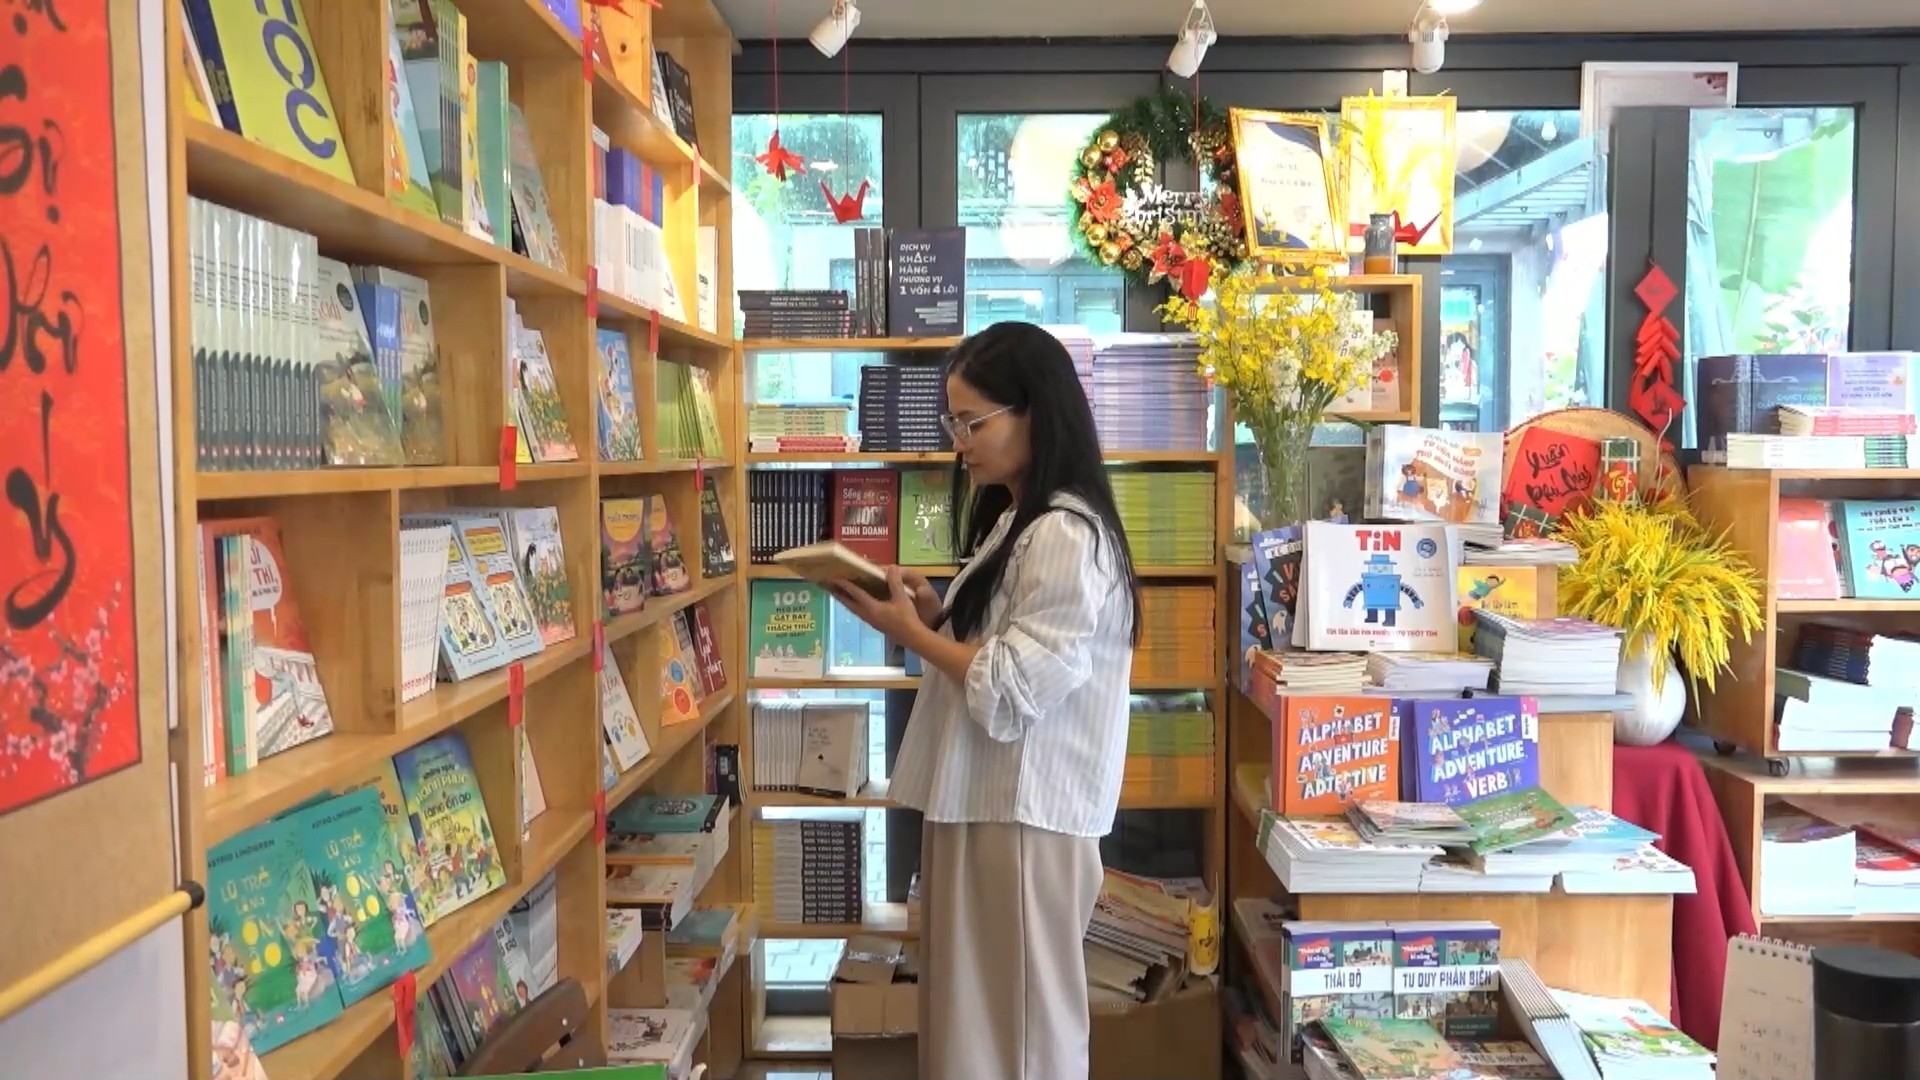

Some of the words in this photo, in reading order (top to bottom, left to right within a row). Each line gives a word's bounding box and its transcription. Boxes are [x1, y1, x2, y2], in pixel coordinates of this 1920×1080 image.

[1140, 182, 1206, 210] Merry
[900, 286, 907, 295] 1
[932, 285, 941, 295] 4
[841, 526, 860, 536] KINH
[862, 526, 889, 536] DOANH
[773, 590, 811, 607] 100
[1300, 712, 1384, 746] ALPHABET
[1430, 714, 1517, 756] ALPHABET
[1300, 737, 1389, 774] ADVENTURE
[1432, 740, 1525, 784] ADVENTURE
[1303, 764, 1388, 800] ADJECTIVE
[1466, 771, 1508, 799] VERB
[1324, 970, 1345, 989] THÁI
[1418, 971, 1437, 988] DUY
